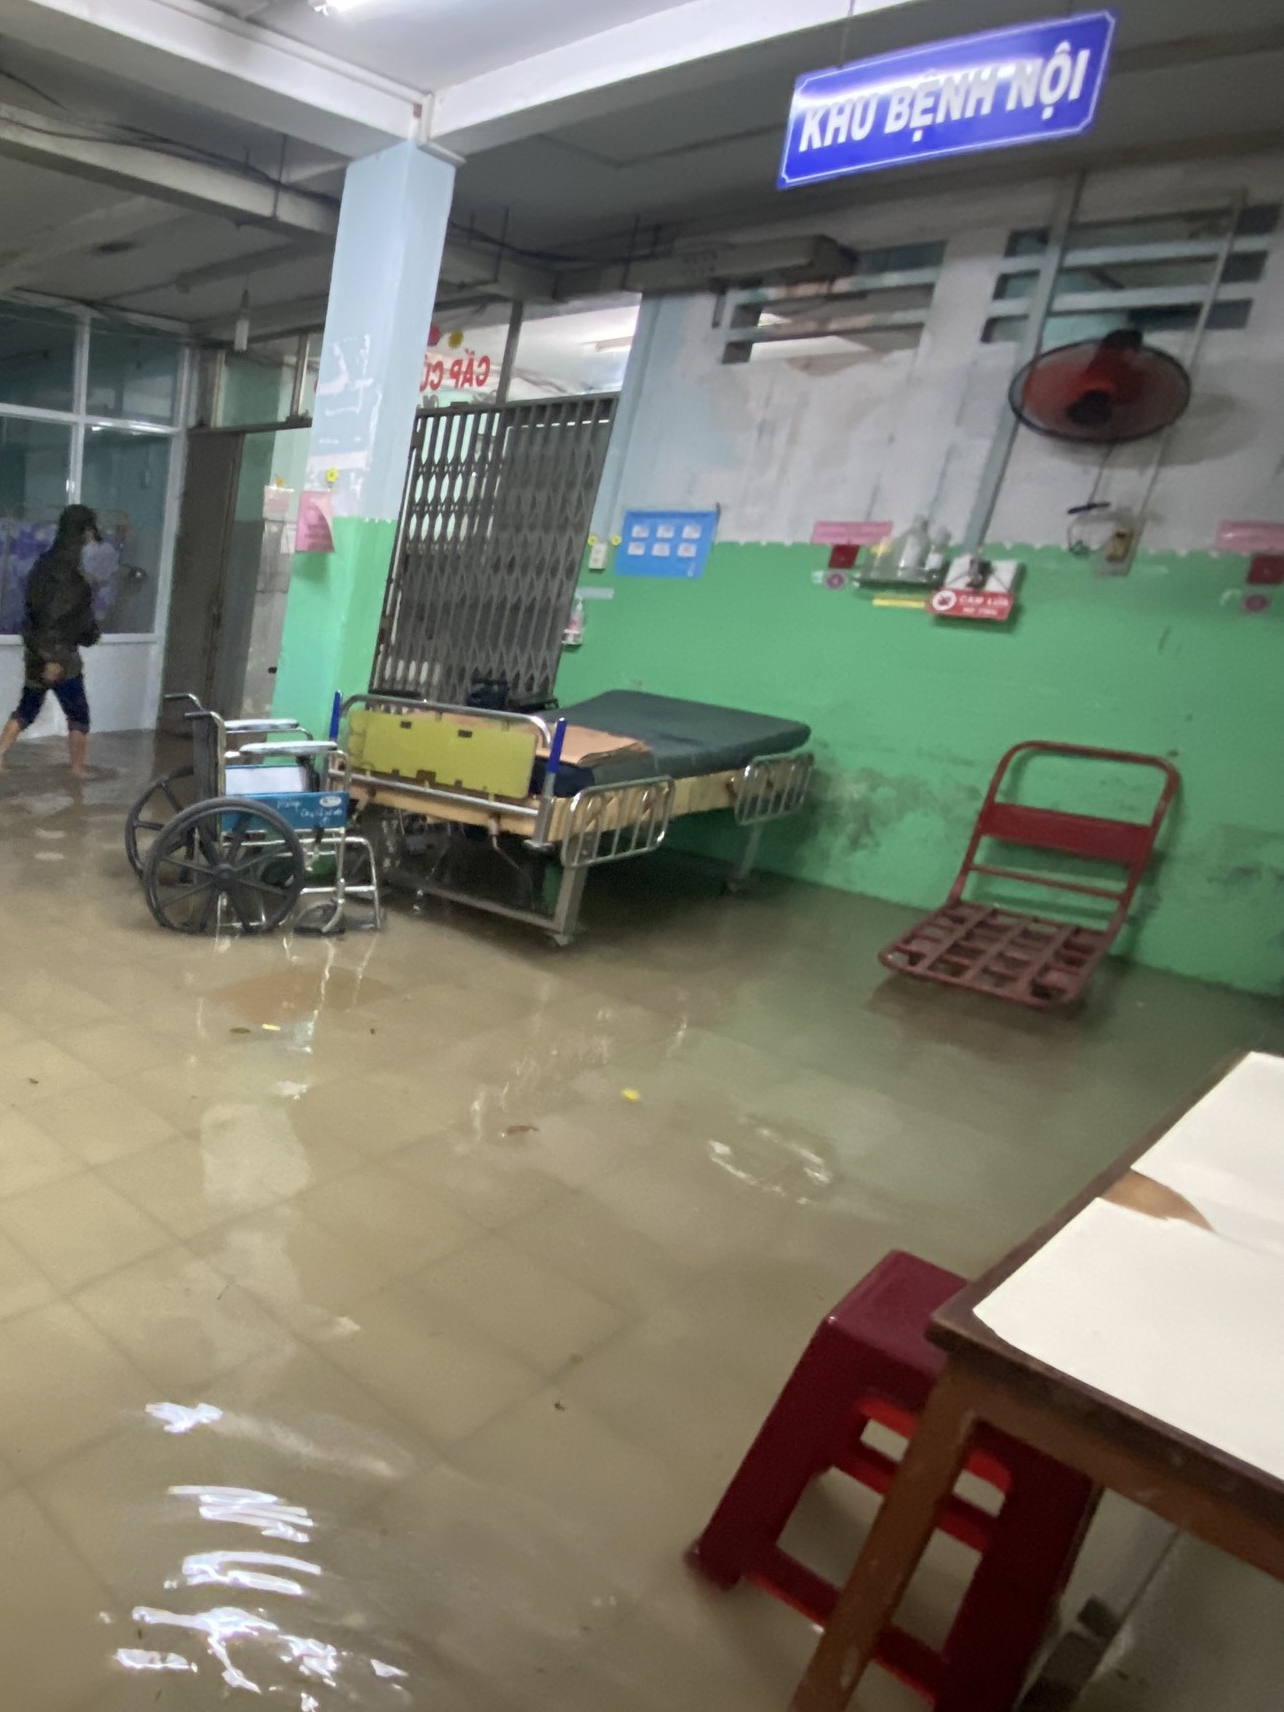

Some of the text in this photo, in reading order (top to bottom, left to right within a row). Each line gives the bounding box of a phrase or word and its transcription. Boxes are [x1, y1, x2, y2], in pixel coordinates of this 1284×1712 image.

[798, 40, 1091, 153] KHU BỆNH NỘI
